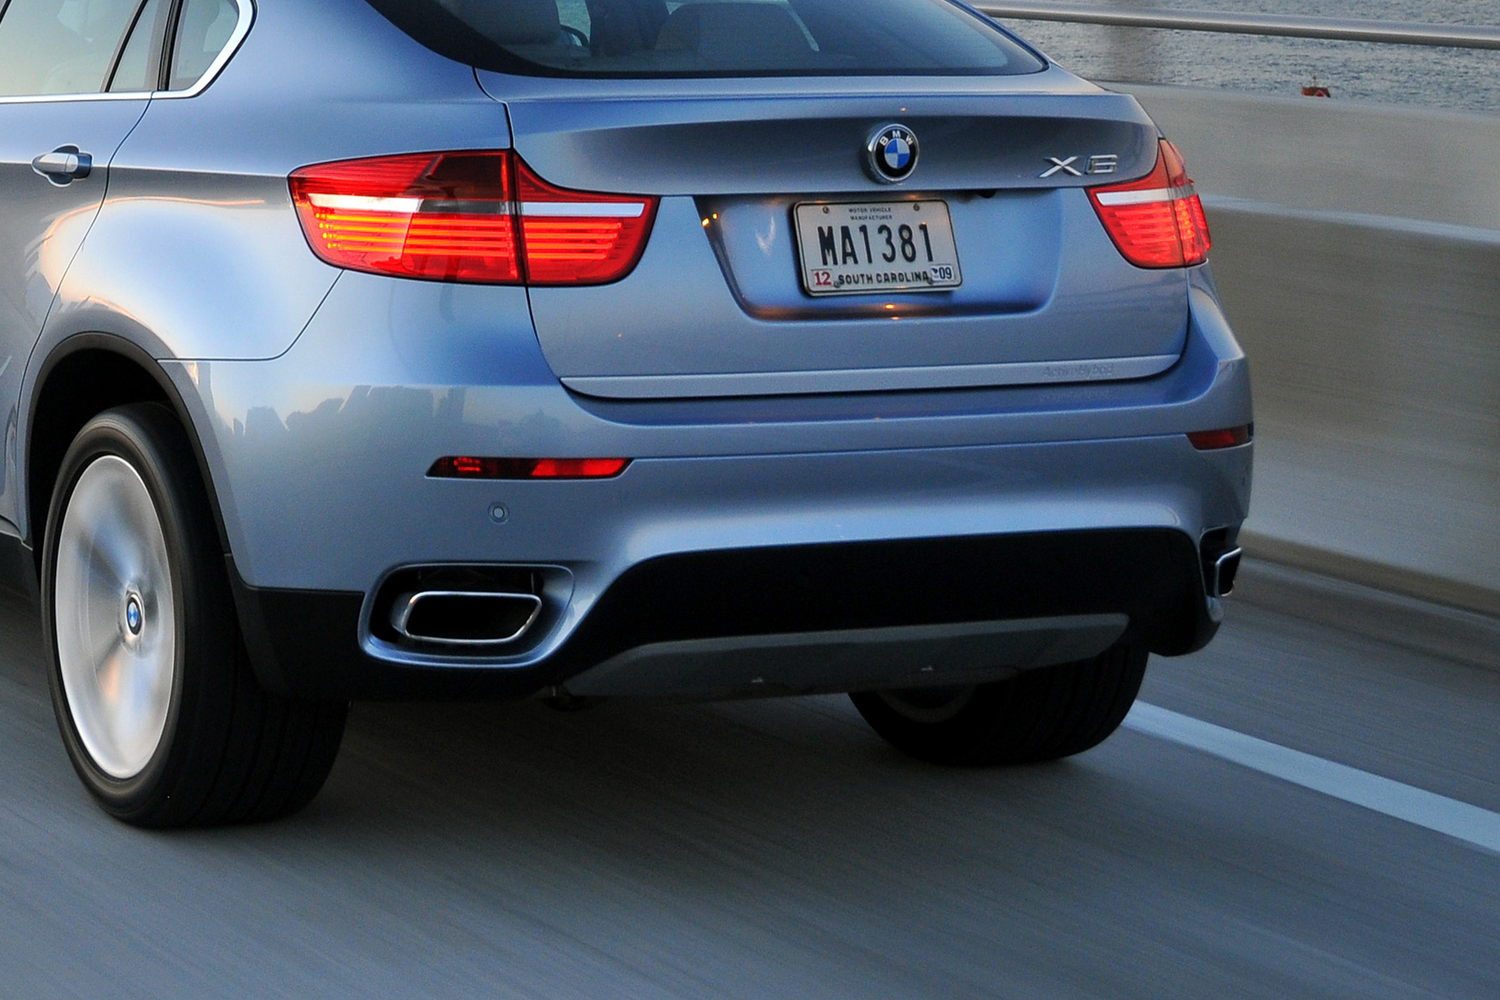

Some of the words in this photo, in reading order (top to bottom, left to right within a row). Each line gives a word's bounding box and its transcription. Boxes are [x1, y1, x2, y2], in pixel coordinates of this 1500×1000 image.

[879, 130, 914, 146] BMW
[1038, 154, 1119, 178] X6
[817, 223, 933, 266] MA1381
[814, 271, 832, 286] 12
[838, 273, 873, 285] SOUTH
[876, 271, 929, 283] CAROLINA
[939, 266, 952, 280] 09
